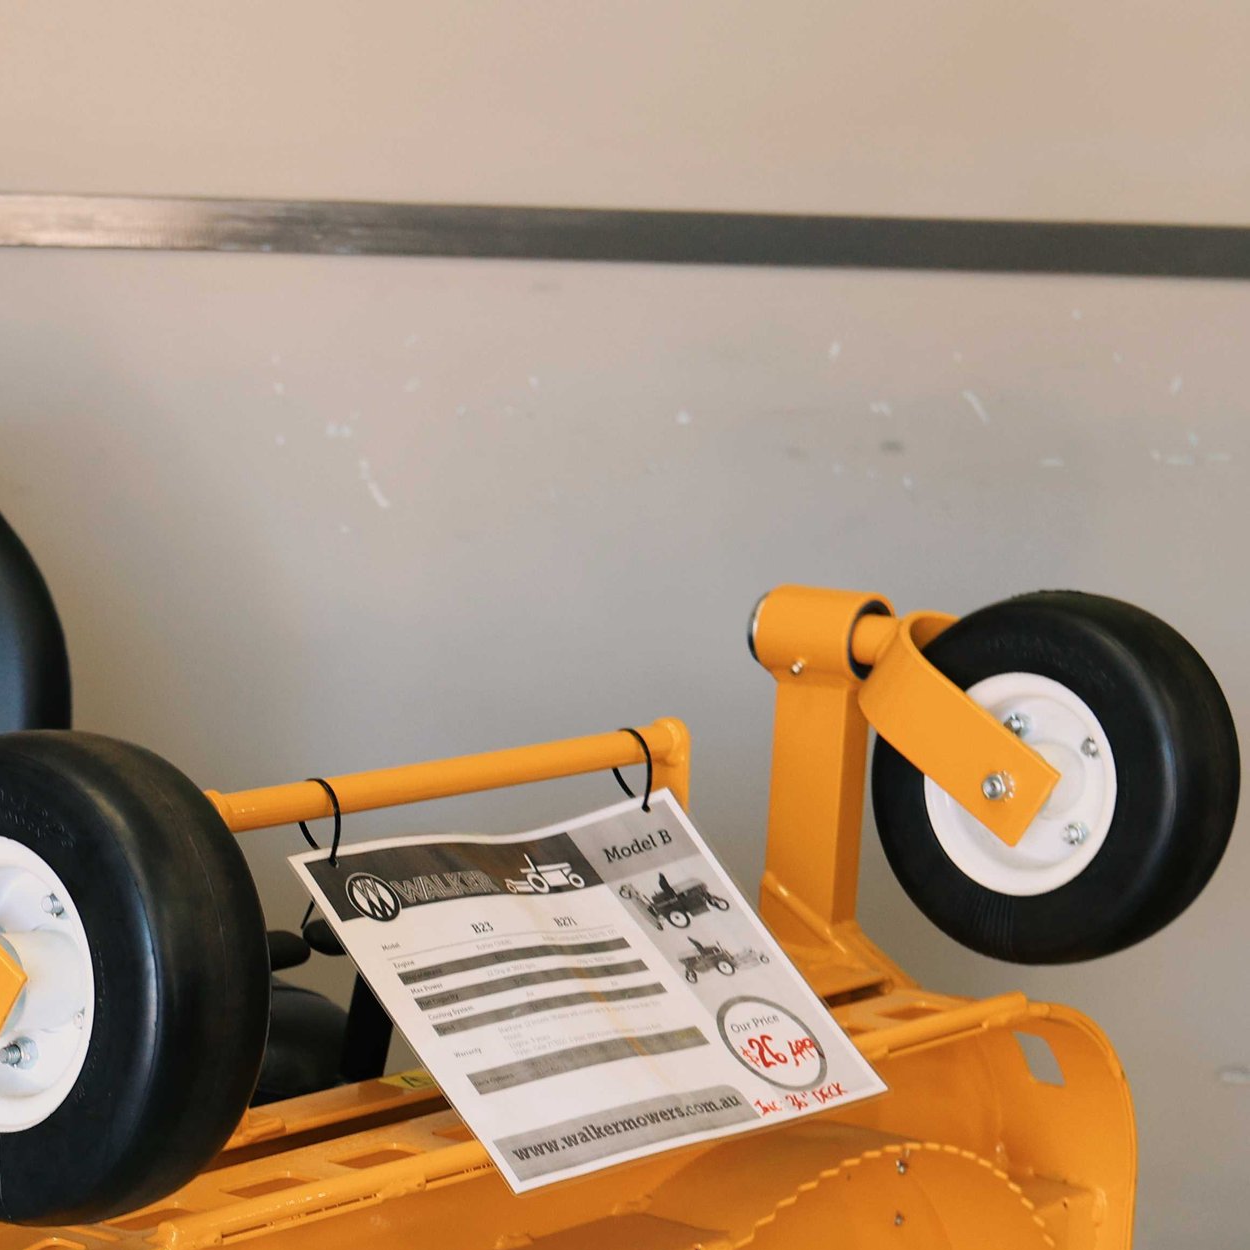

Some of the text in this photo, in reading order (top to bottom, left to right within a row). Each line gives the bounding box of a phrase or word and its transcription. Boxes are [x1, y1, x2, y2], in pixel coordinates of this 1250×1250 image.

[602, 829, 673, 863] Model B
[390, 869, 500, 904] WALKER
[470, 921, 494, 934] B23
[730, 1013, 781, 1034] Our Price
[812, 1082, 848, 1105] DECK
[512, 1094, 742, 1161] www.walkermowers.com.au
